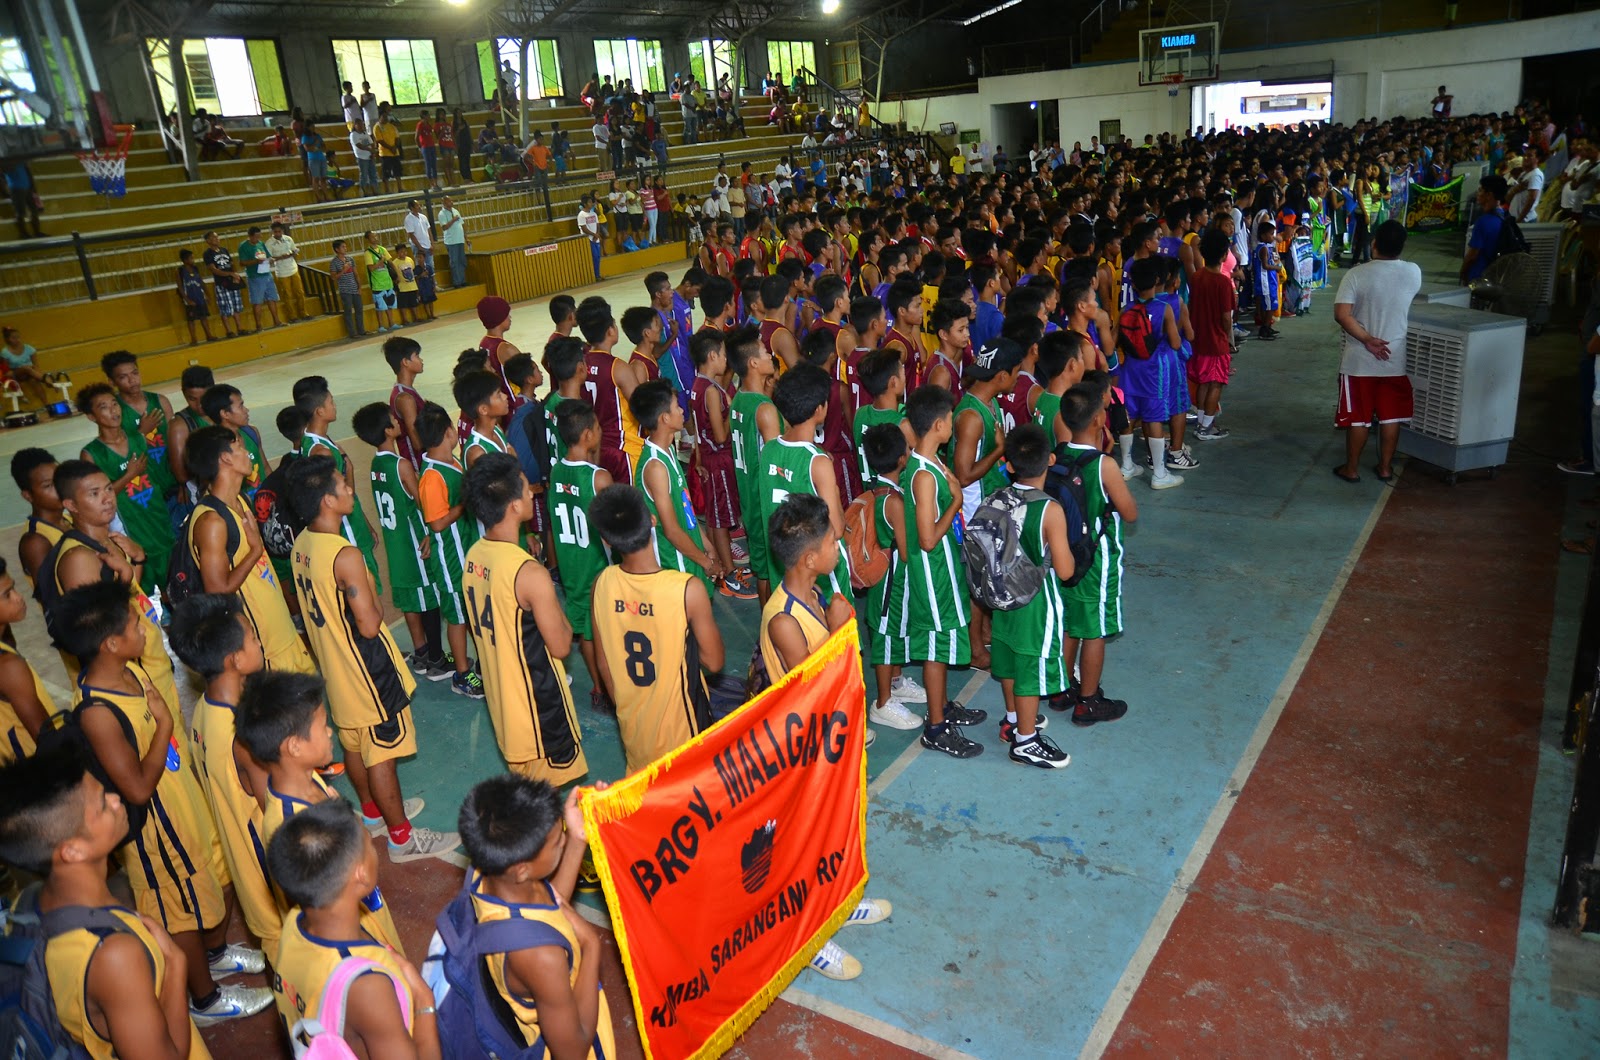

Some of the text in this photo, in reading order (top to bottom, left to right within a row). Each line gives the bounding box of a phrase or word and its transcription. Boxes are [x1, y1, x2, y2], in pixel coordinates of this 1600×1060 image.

[1161, 34, 1196, 48] KIAMBA
[374, 490, 397, 531] 13
[554, 502, 590, 549] 10
[296, 573, 326, 628] 13
[465, 585, 497, 648] 14
[623, 630, 656, 687] 8
[630, 785, 722, 905] BRGY.
[710, 879, 809, 975] SARANGANI
